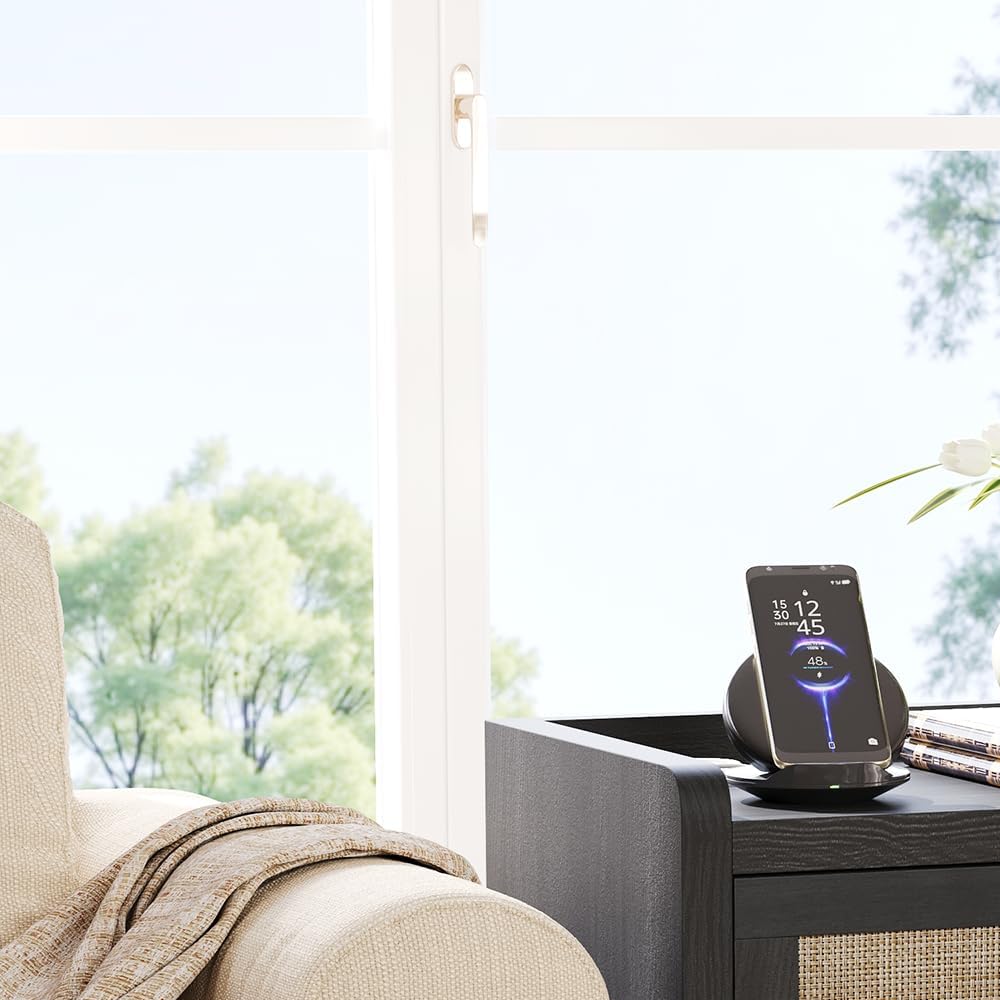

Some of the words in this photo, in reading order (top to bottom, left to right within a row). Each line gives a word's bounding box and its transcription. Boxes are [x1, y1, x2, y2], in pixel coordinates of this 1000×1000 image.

[772, 600, 787, 609] 15
[794, 600, 821, 617] 12
[773, 611, 789, 620] 30
[797, 619, 825, 635] 45
